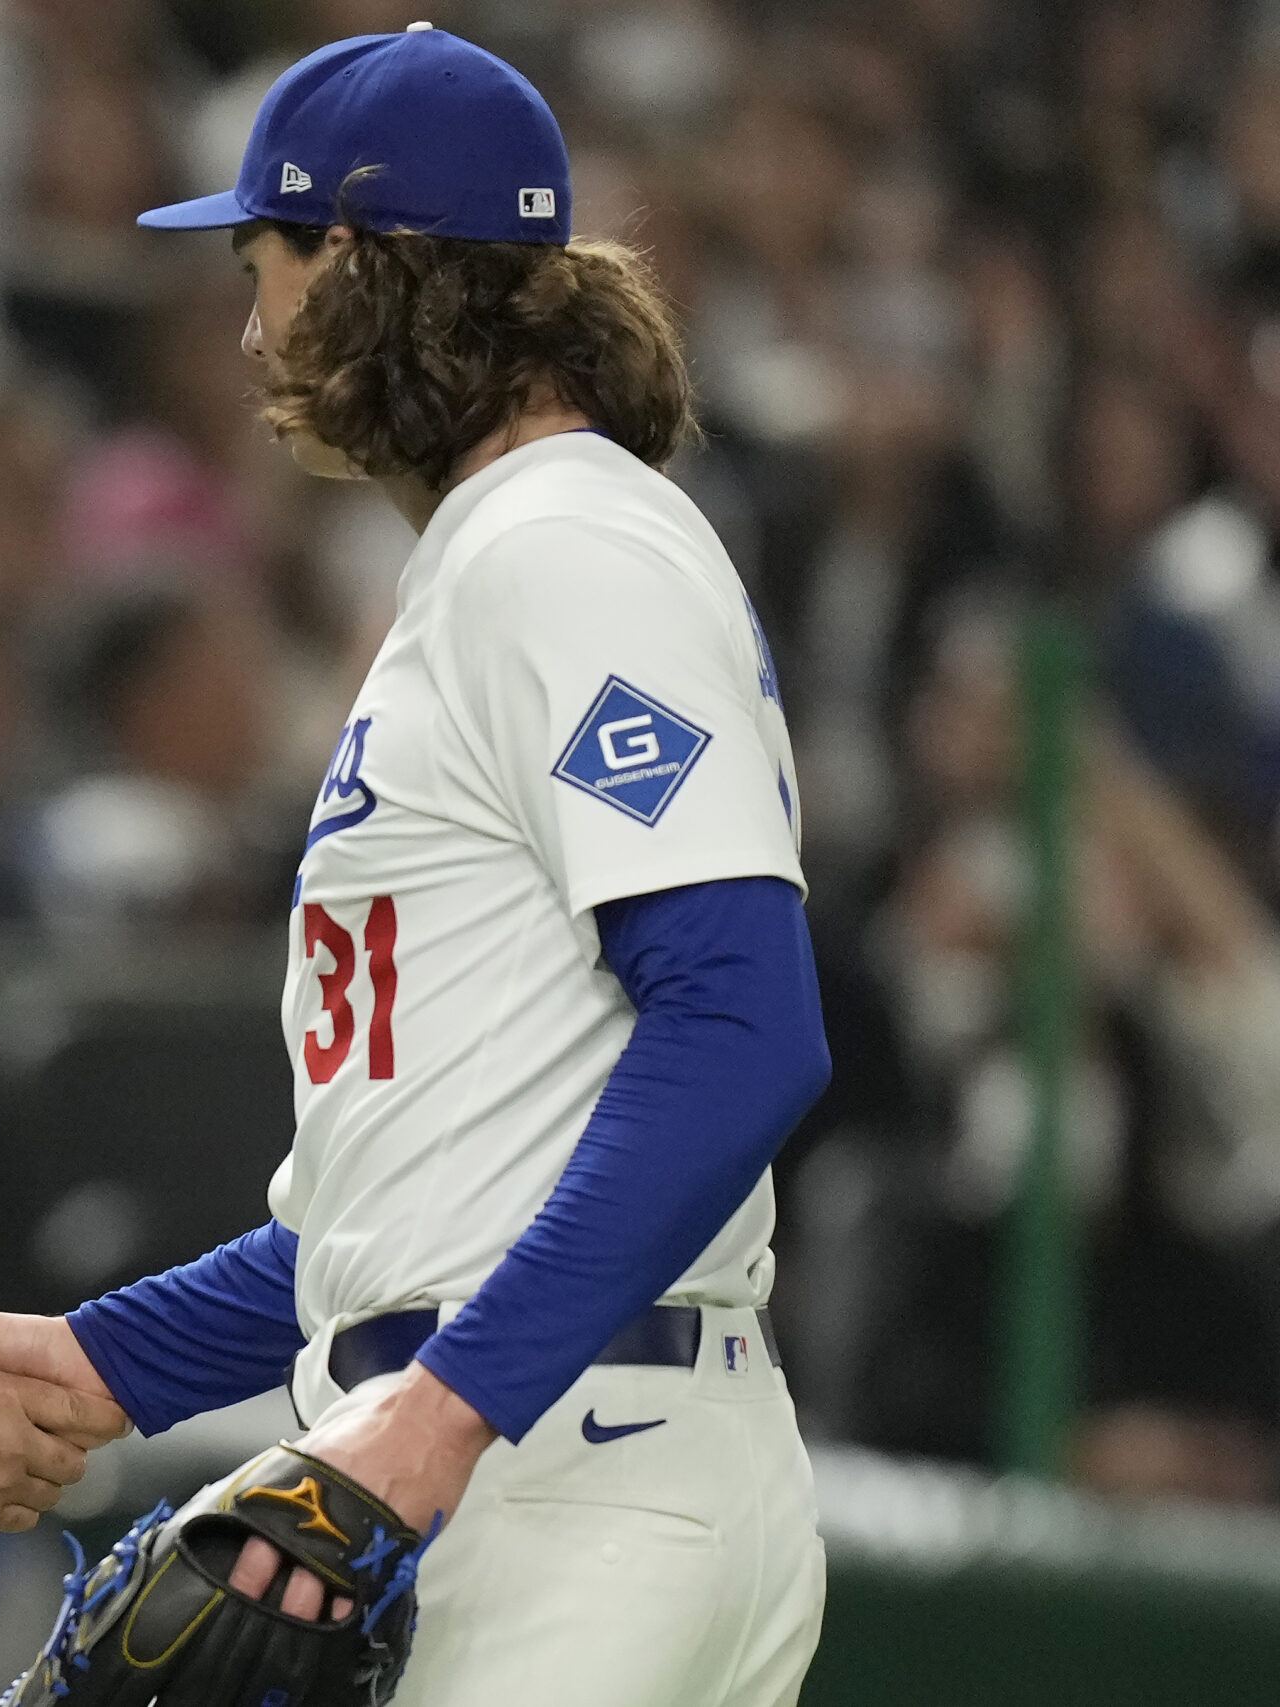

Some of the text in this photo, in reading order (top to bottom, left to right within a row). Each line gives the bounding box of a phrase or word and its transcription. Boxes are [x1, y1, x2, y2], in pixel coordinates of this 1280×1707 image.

[597, 714, 660, 770] G
[594, 762, 681, 790] GUGGENHEIM
[304, 896, 397, 1084] 31
